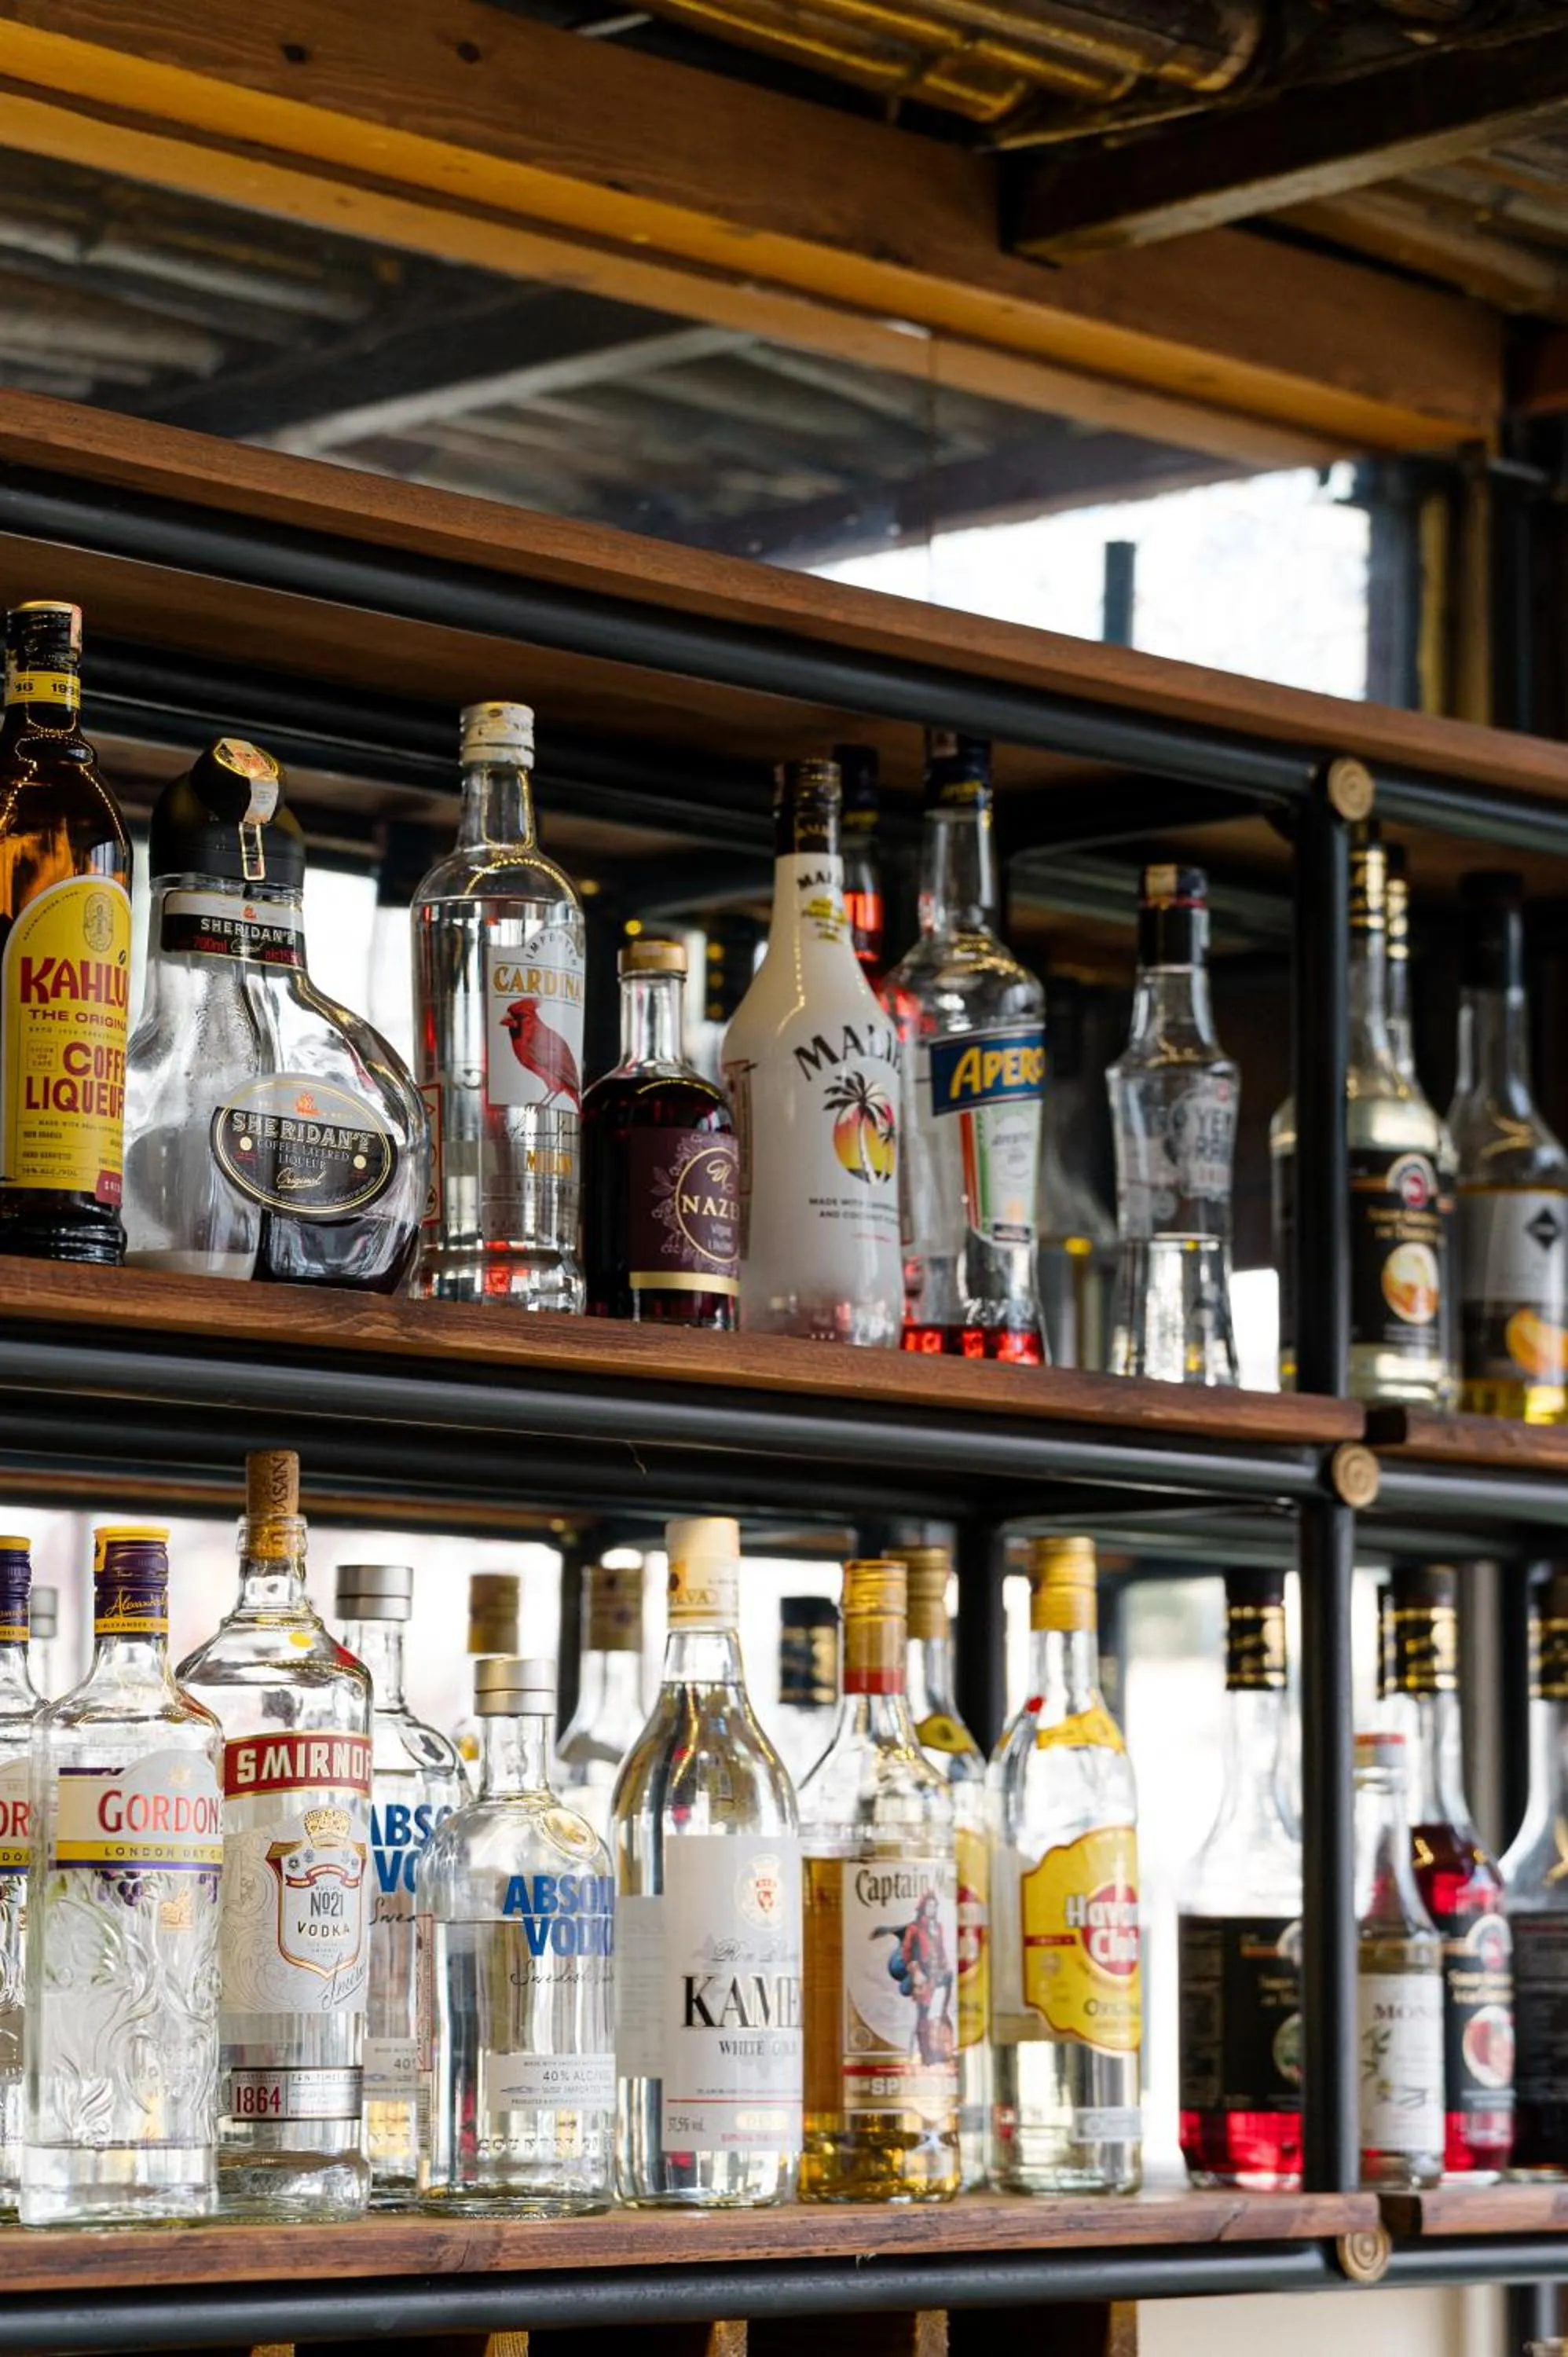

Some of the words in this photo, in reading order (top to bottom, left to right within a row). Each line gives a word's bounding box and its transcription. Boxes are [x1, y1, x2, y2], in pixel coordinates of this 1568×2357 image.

[20, 950, 127, 1009] KAHLÚ
[493, 966, 583, 1006] CARDINA
[28, 1008, 68, 1021] THE
[75, 1011, 126, 1031] ORIGIN
[793, 1024, 902, 1082] MALI
[97, 1789, 223, 1835] GORDON
[104, 1846, 175, 1858] LONDON
[855, 1868, 929, 1908] Captain
[297, 1920, 351, 1938] VODKA
[719, 2040, 765, 2056] WHITE
[236, 2086, 282, 2113] 1864
